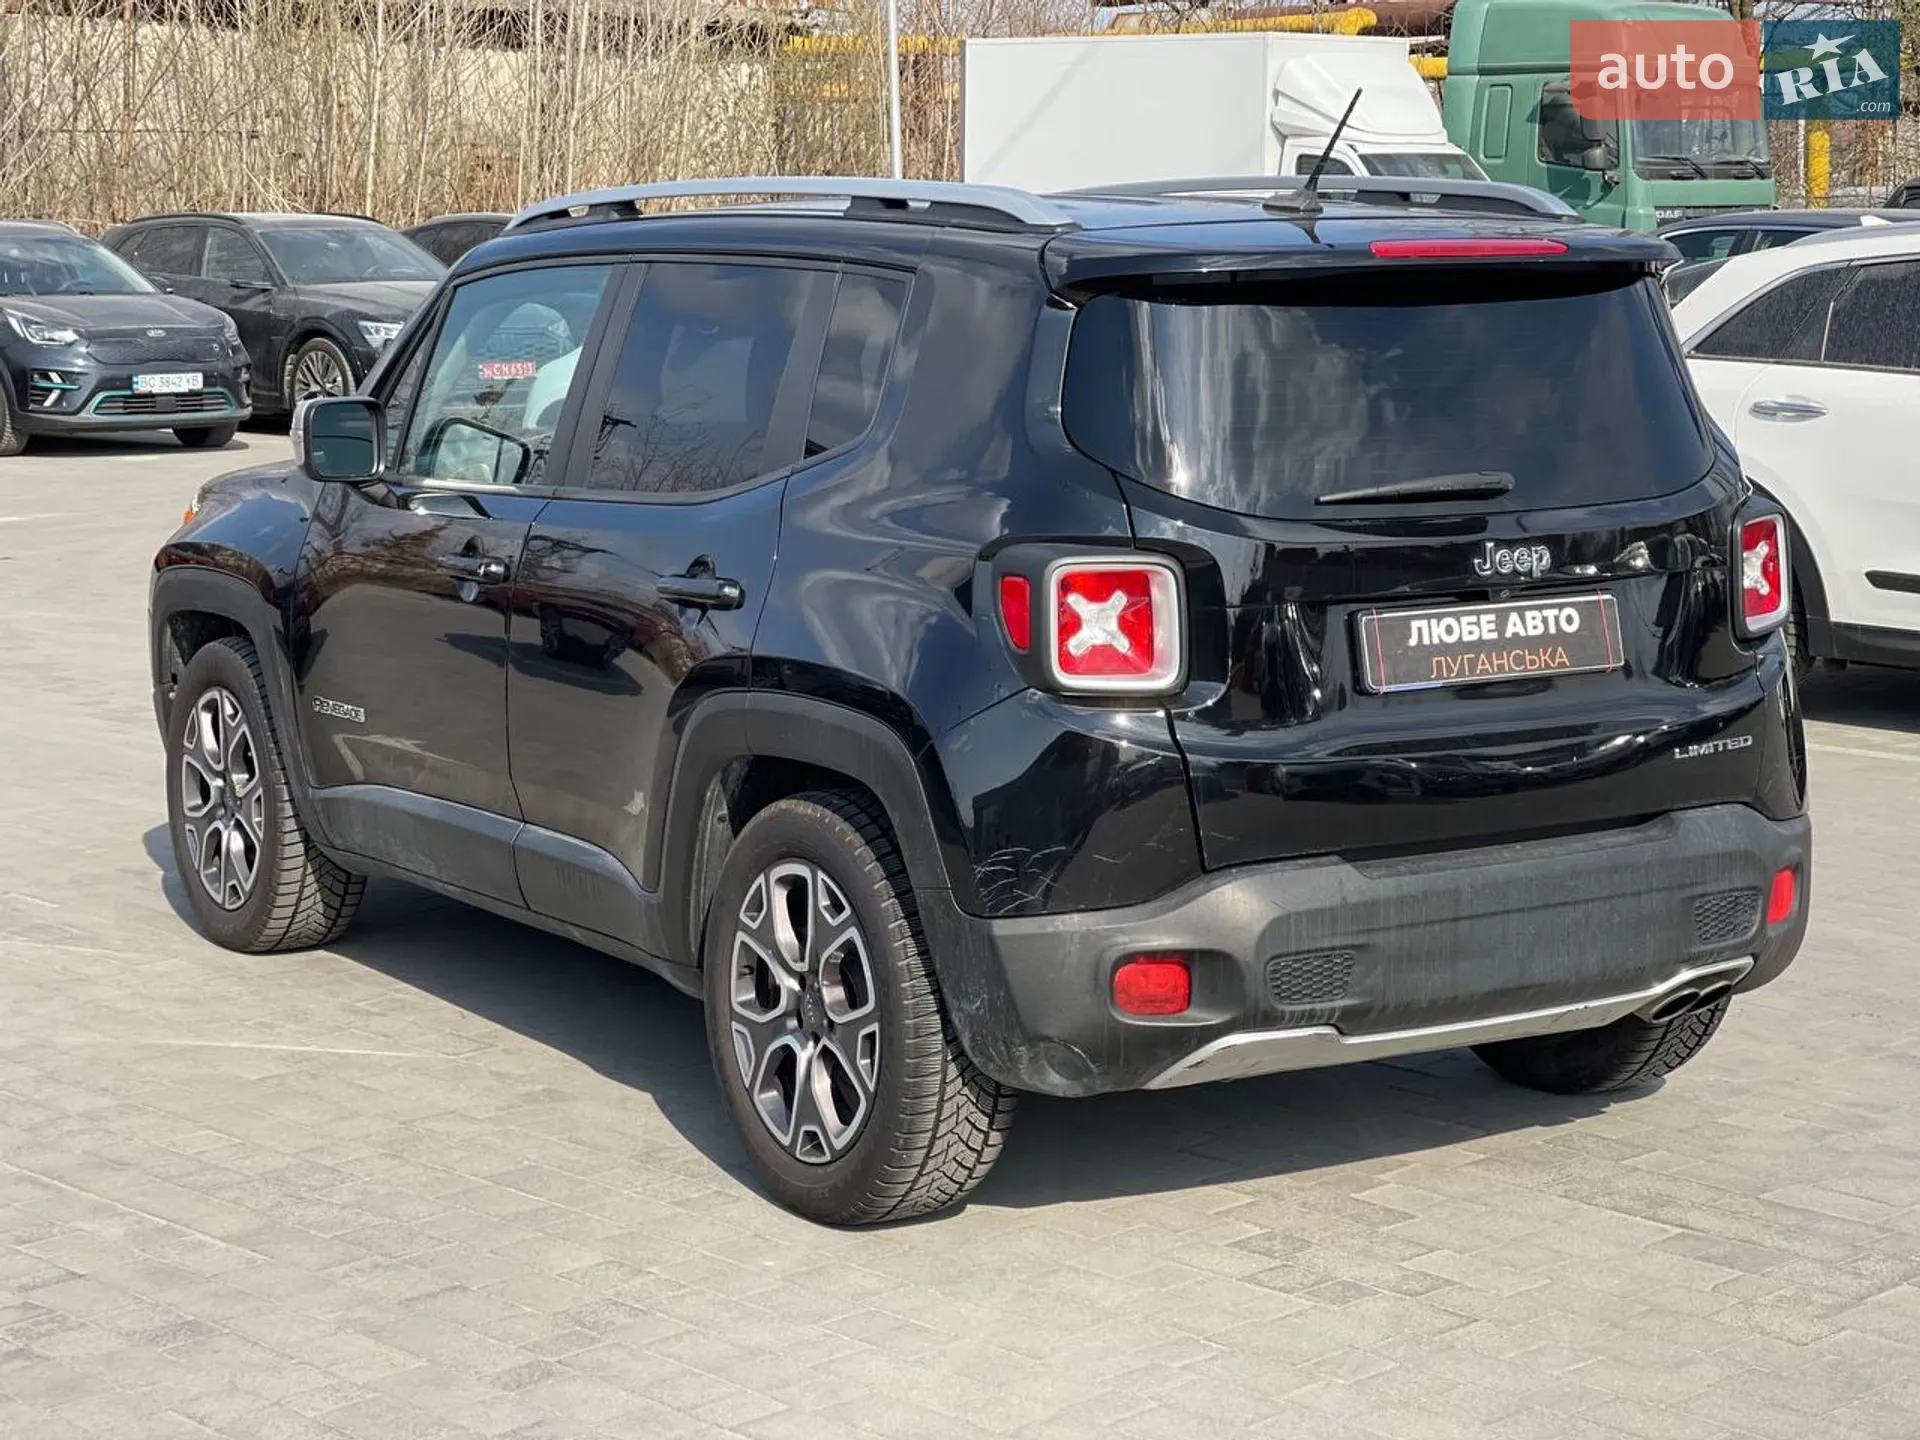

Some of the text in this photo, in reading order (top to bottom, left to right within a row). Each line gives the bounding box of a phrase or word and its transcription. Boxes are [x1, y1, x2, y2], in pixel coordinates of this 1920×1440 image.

[1474, 541, 1551, 578] Jeep
[1407, 607, 1580, 647] ЛЮБЕ АВТО
[1430, 646, 1570, 678] ЛУГАНСЬКА
[1673, 735, 1753, 759] LIMITED
